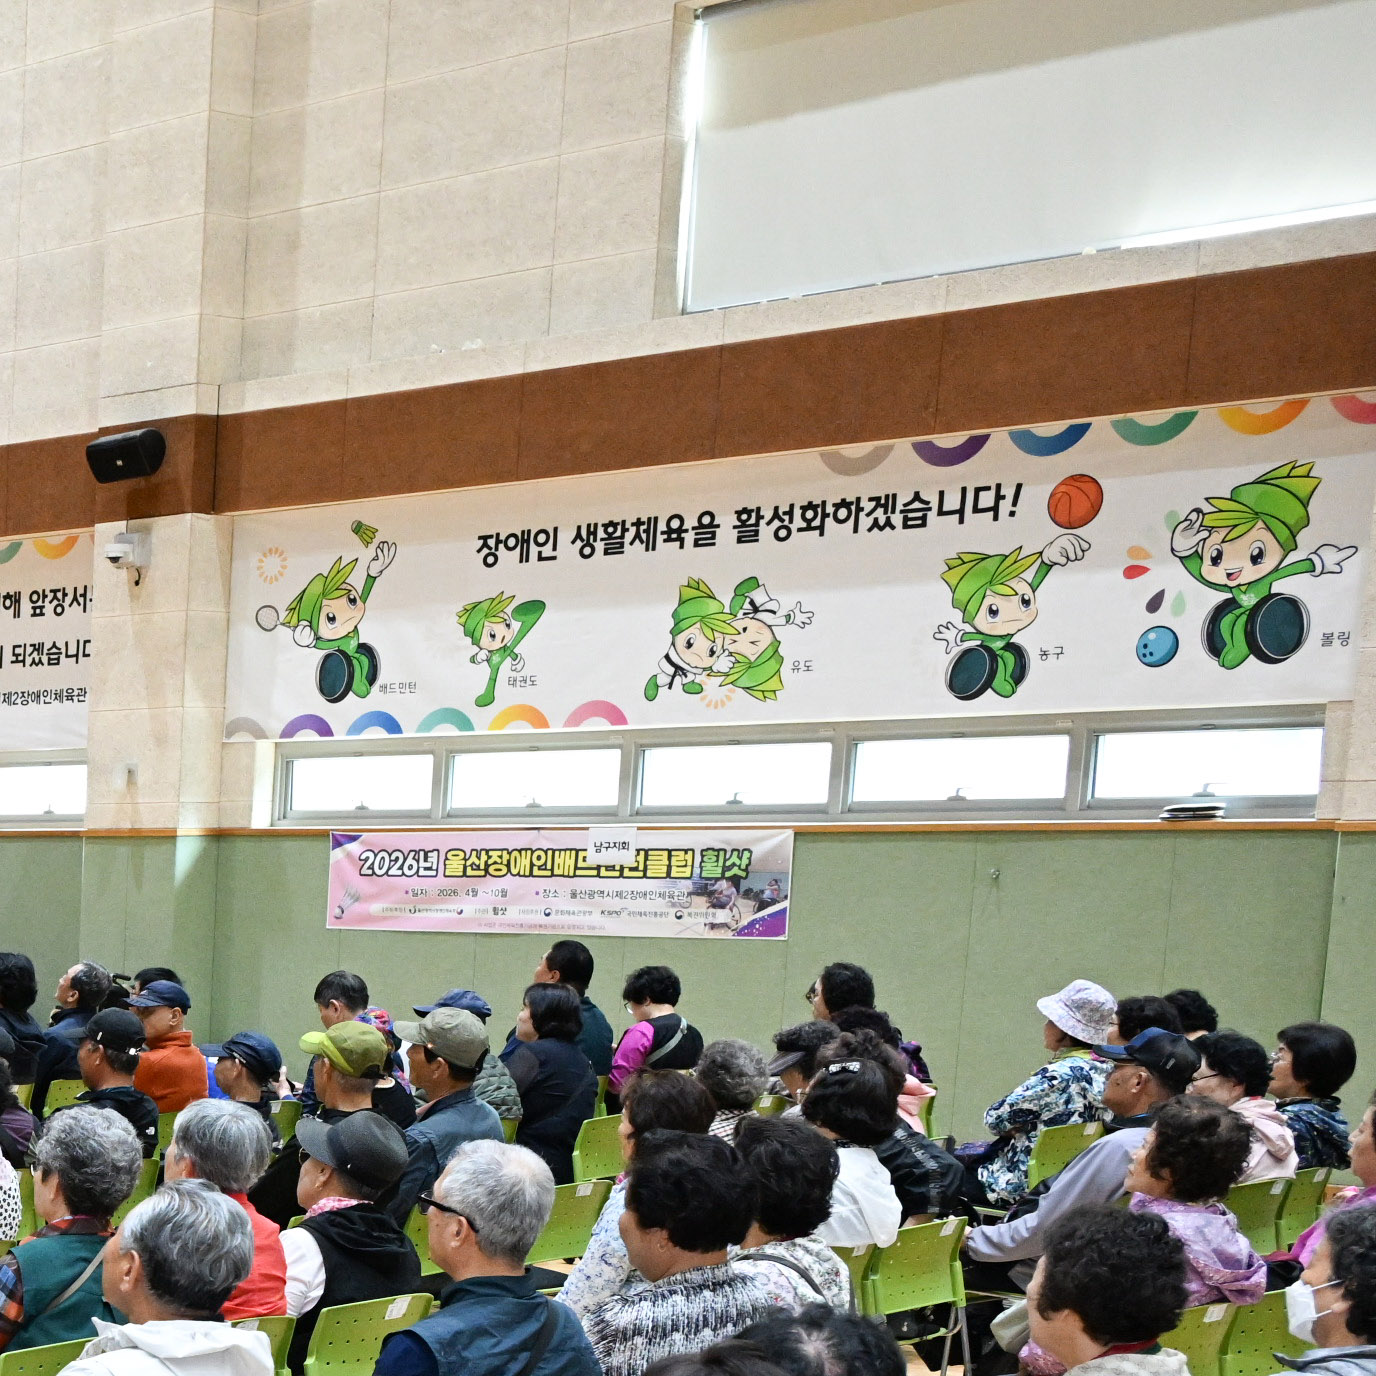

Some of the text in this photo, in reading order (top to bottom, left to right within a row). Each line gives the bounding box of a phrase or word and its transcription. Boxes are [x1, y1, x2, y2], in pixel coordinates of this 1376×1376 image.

[476, 482, 1023, 568] 장애인 생활체육을 활성화하겠습니다!
[29, 585, 93, 618] 앞장서
[1320, 631, 1350, 647] 볼링
[1038, 646, 1064, 661] 농구
[791, 660, 813, 674] 유도
[378, 681, 417, 695] 배드민턴
[507, 675, 538, 688] 태권도
[594, 841, 630, 853] 남구지회
[359, 848, 440, 878] 2026년
[700, 848, 752, 879] 휠샷
[411, 888, 428, 897] 일자
[437, 888, 461, 897] 2026.
[465, 888, 479, 898] 4월
[542, 888, 559, 899] 장소
[569, 889, 688, 901] 울산광역시제2장애인체육관
